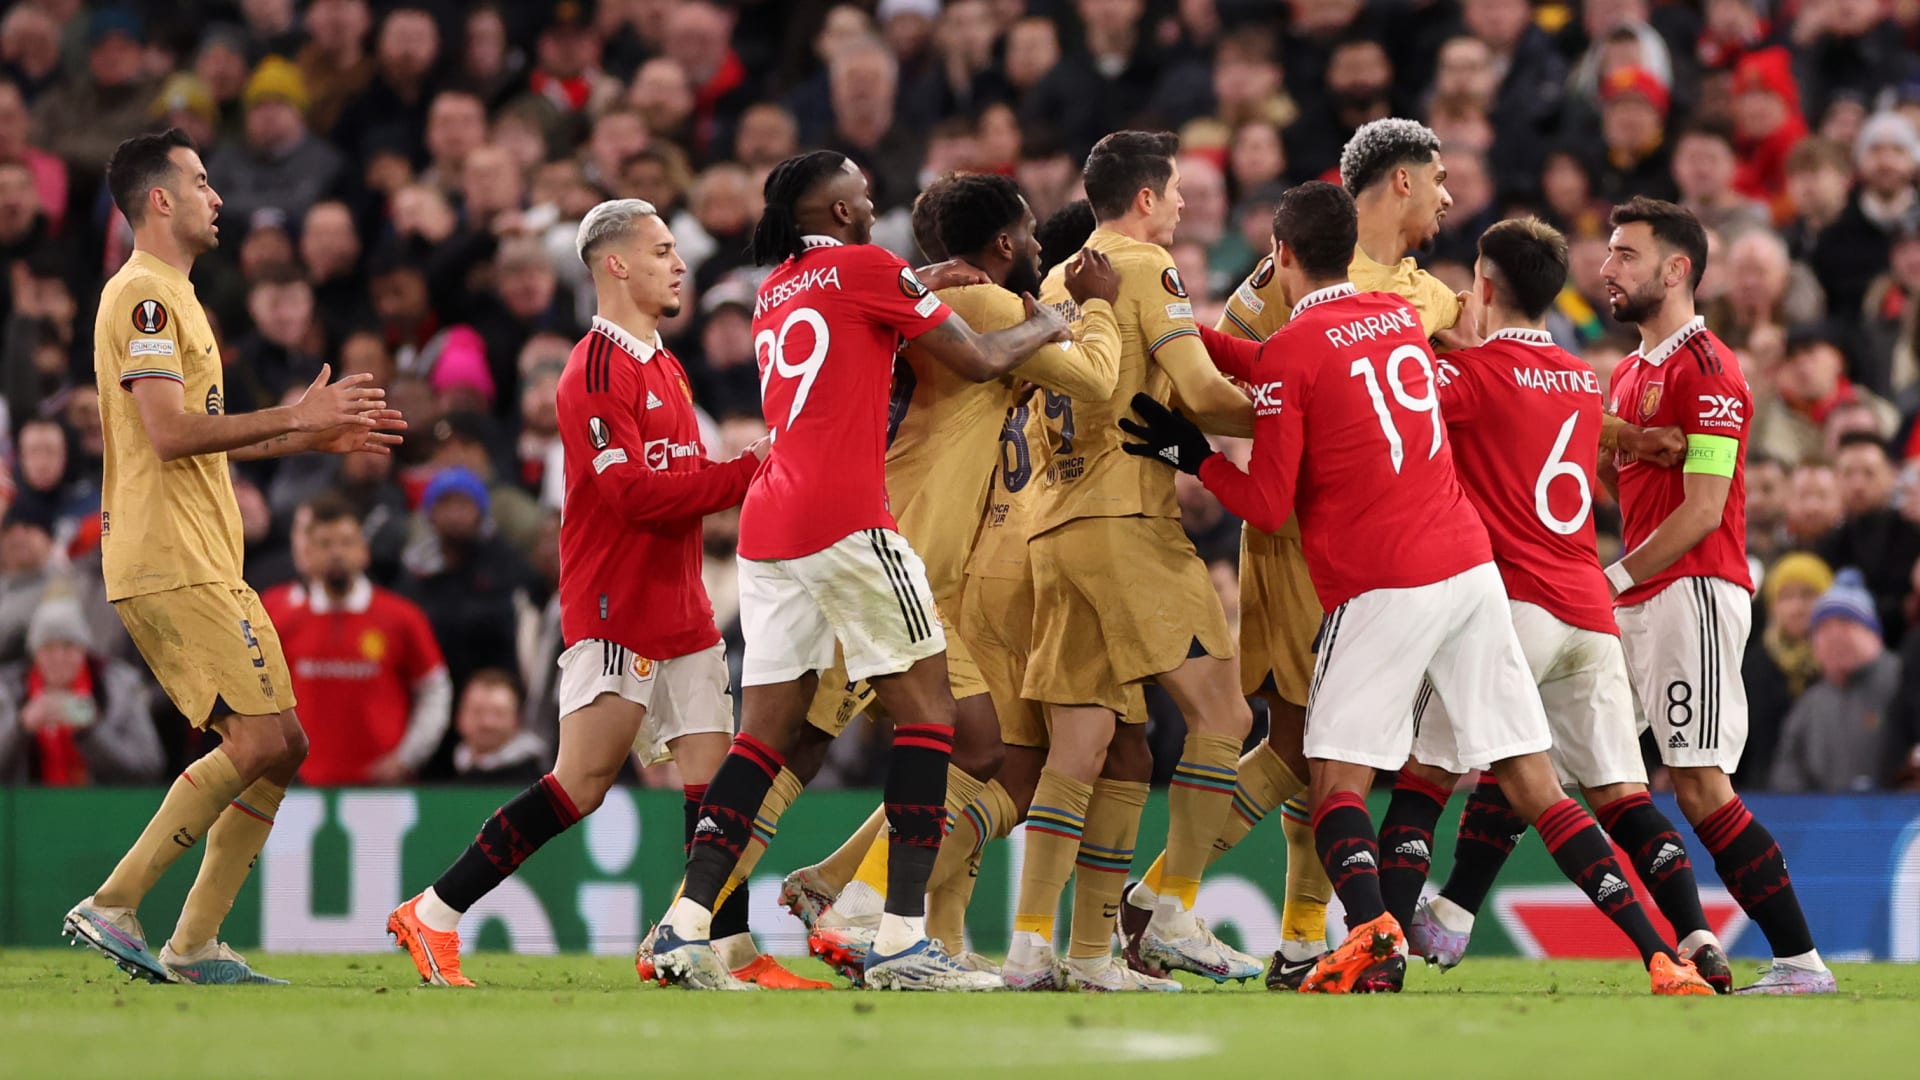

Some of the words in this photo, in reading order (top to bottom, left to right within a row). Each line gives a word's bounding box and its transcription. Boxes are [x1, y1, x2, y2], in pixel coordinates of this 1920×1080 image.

[1325, 307, 1417, 348] R.VARANE
[1350, 344, 1437, 475] 19
[1698, 395, 1744, 423] DXC
[1534, 410, 1591, 535] 6
[1687, 448, 1714, 457] SPECT
[240, 620, 264, 667] 5
[1667, 680, 1692, 727] 8
[1650, 848, 1685, 874] adidas
[1597, 881, 1629, 902] adidas
